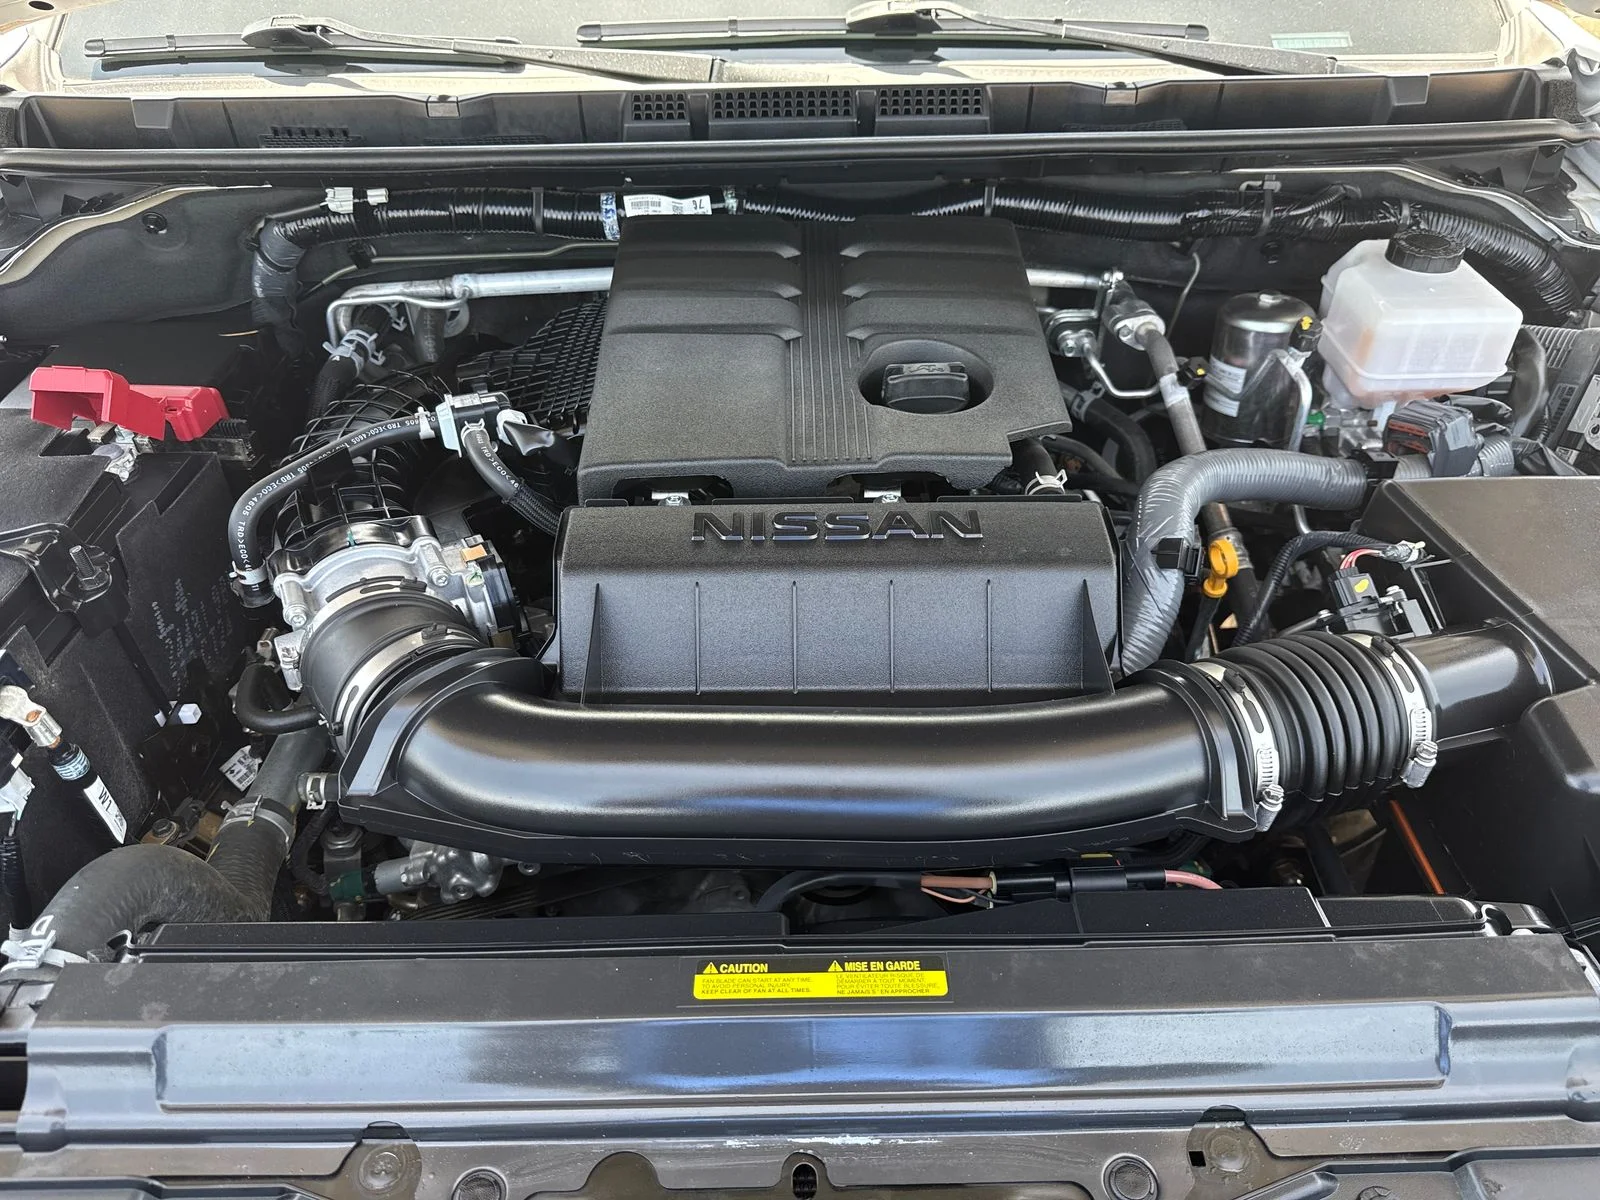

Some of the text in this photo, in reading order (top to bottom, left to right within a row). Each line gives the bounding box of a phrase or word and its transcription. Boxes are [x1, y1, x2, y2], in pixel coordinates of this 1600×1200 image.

[691, 510, 983, 541] NISSAN
[720, 963, 769, 973] CAUTION
[844, 960, 921, 971] MISE EN GARDE
